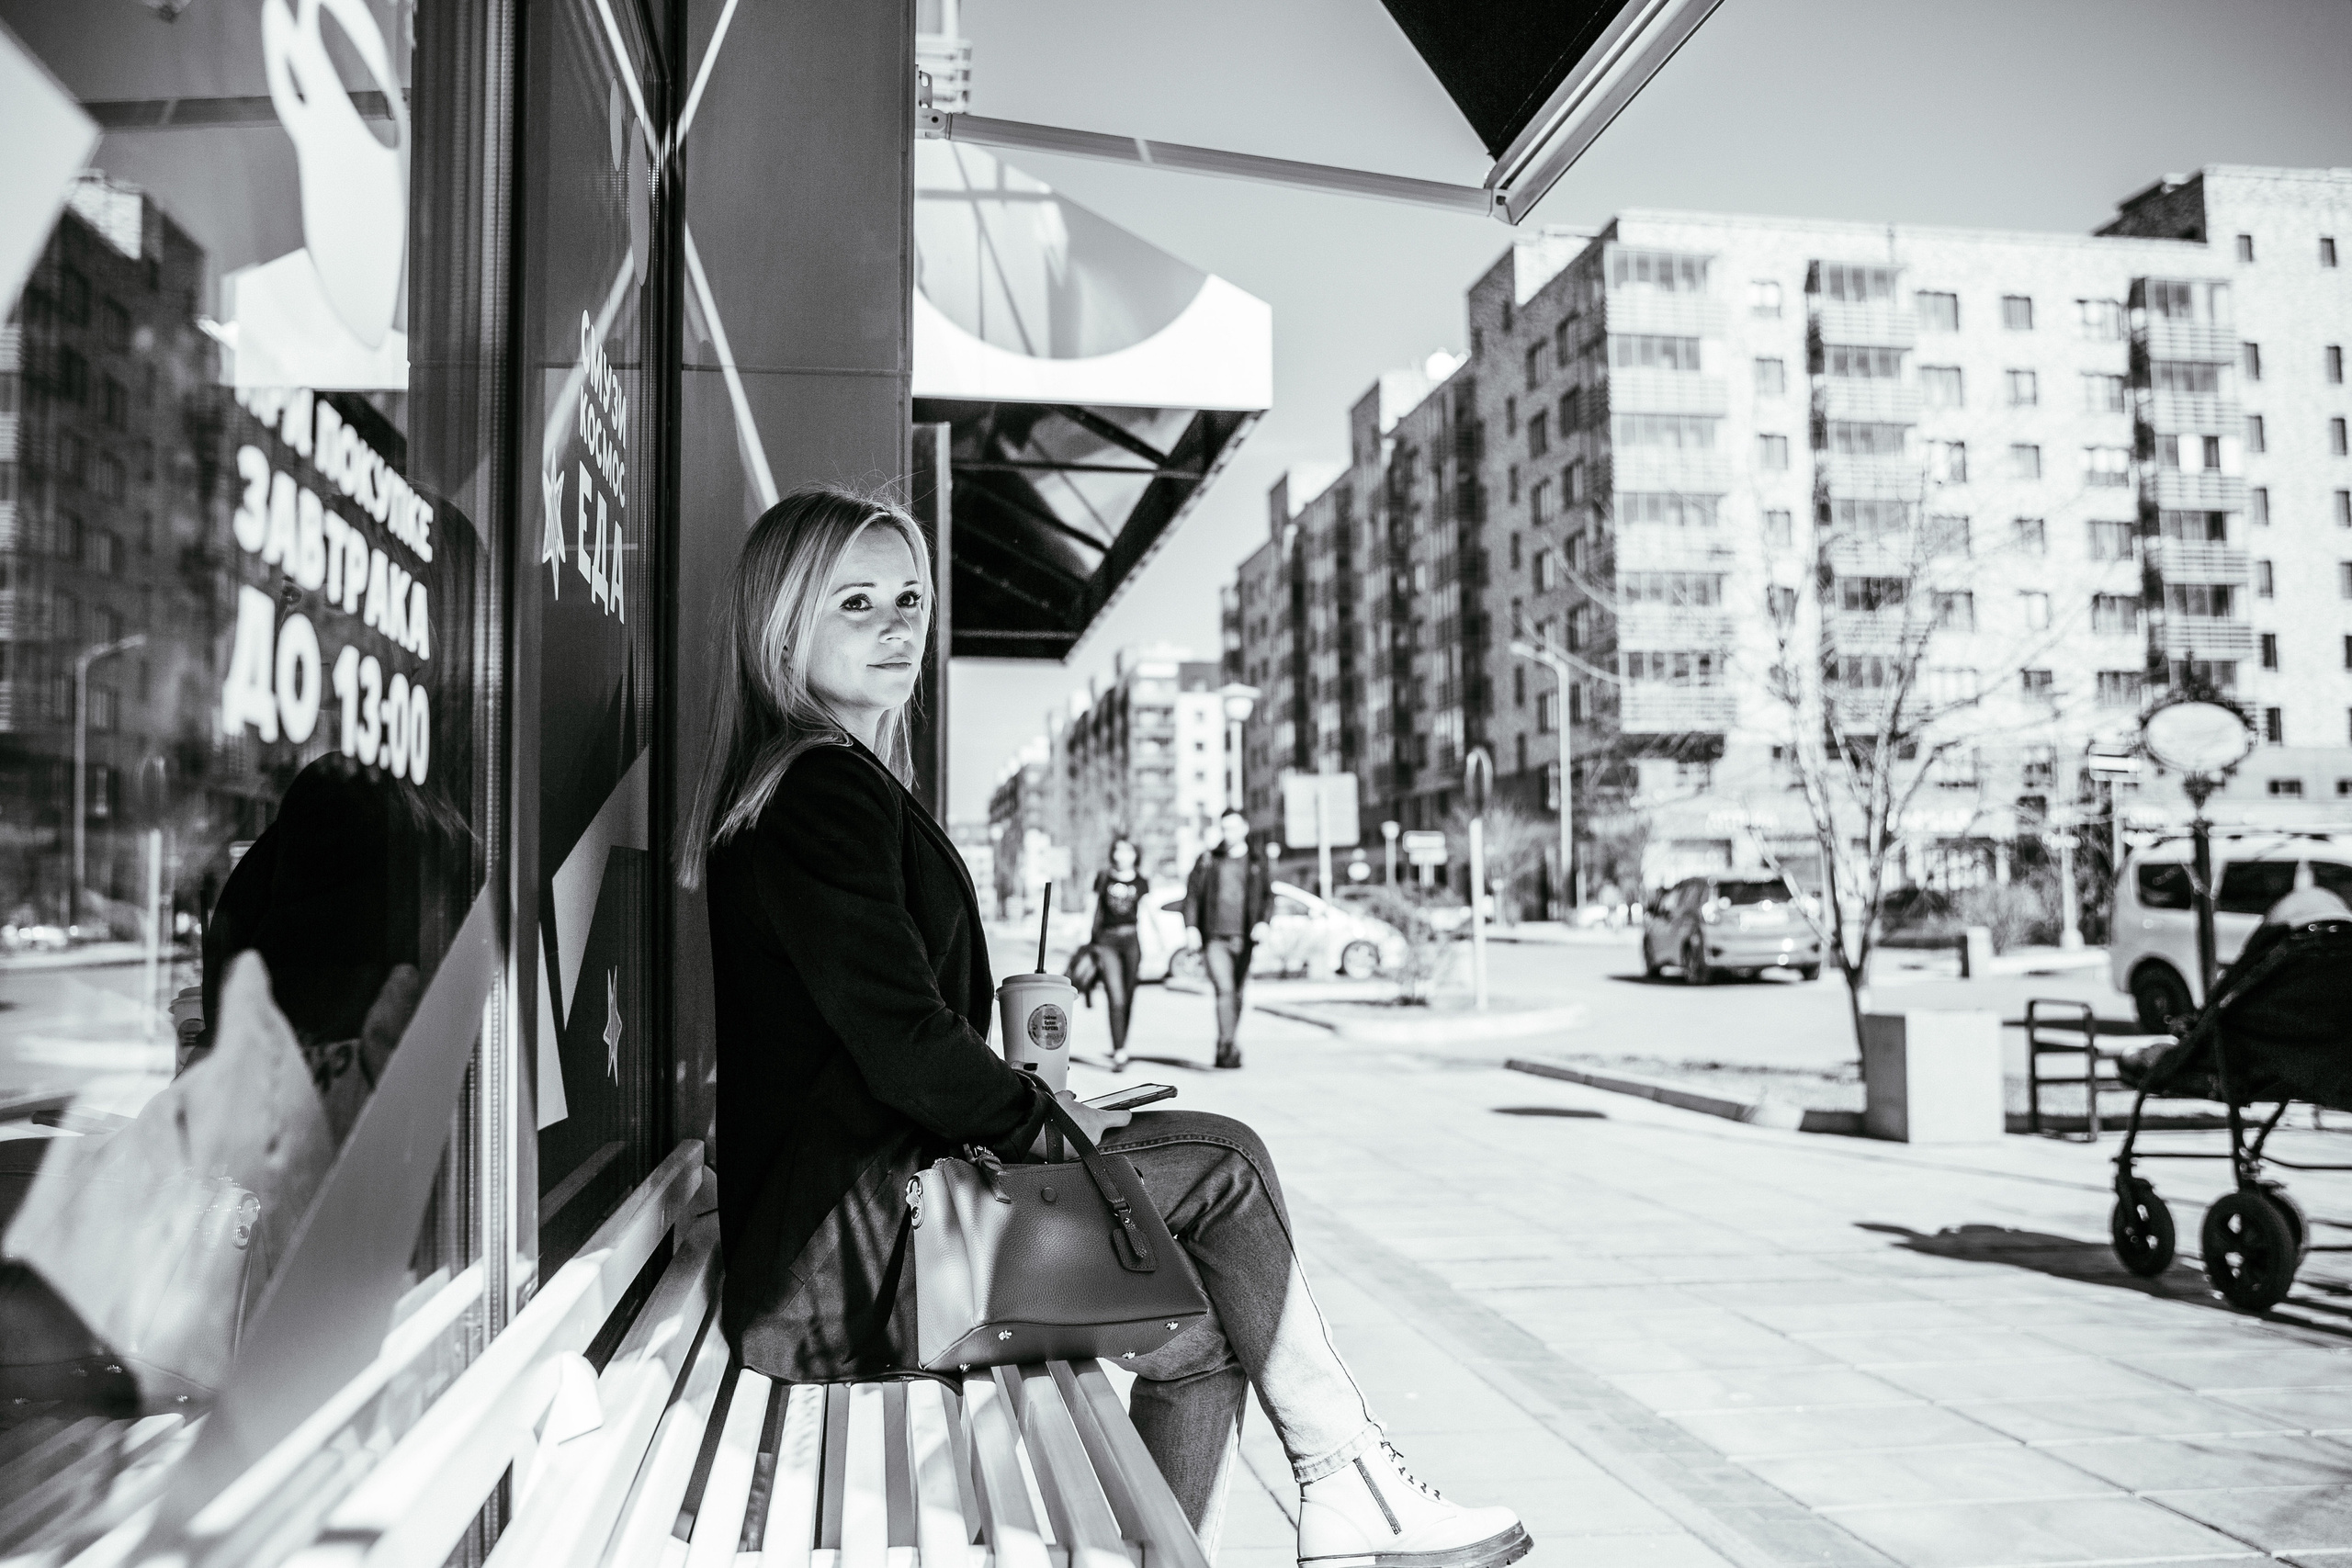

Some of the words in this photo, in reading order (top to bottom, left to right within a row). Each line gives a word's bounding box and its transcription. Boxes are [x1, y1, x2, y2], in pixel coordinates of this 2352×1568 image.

[579, 384, 626, 508] КОСМОС
[581, 309, 627, 450] СМУЗИ
[232, 444, 431, 660] ЗАВТРАКА
[314, 399, 434, 562] ПОКУПКЕ
[577, 459, 625, 625] ЕДА
[221, 583, 322, 745] ДО
[332, 644, 431, 786] 13:00
